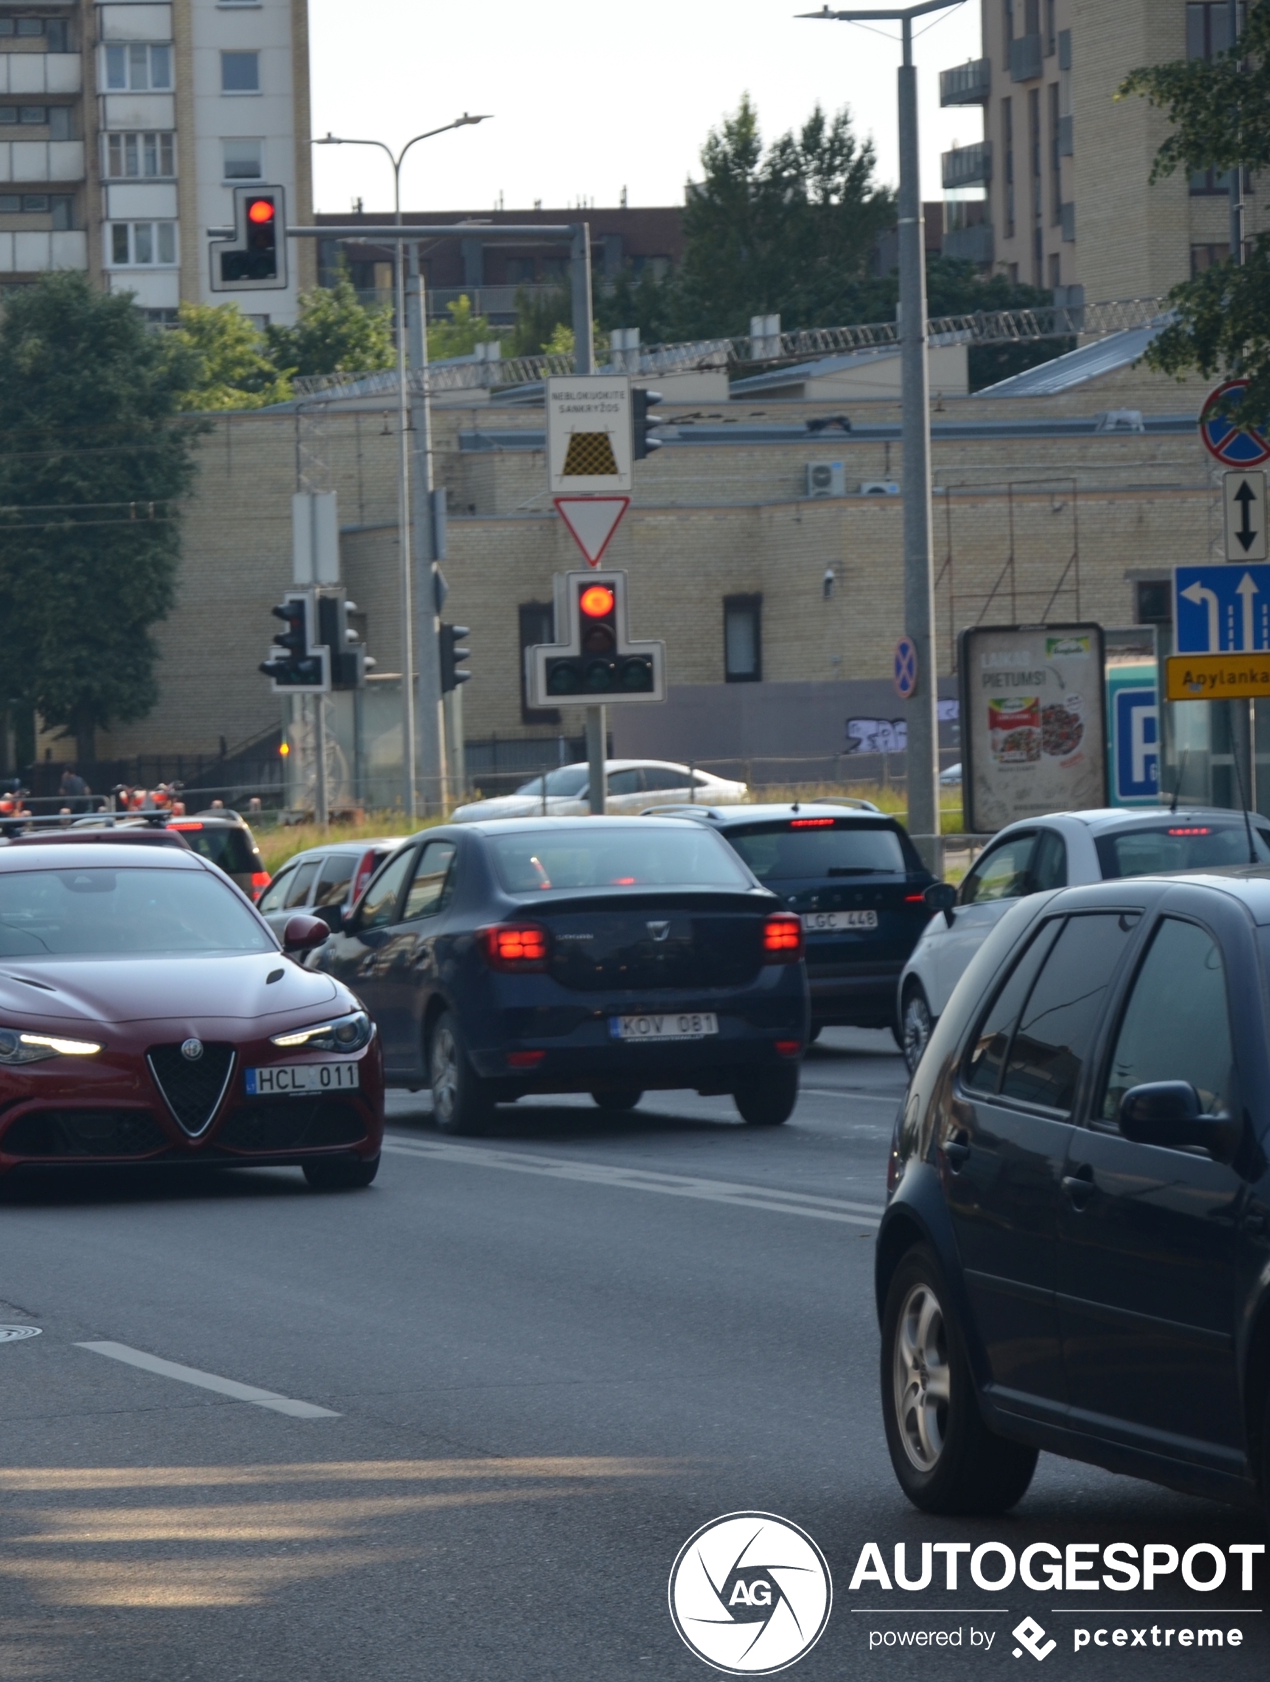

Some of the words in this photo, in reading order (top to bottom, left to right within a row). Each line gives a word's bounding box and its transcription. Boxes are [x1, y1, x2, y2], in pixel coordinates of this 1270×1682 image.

[552, 391, 625, 400] NEBLOKUOKITE
[559, 402, 620, 413] SANKRYŽOS
[805, 913, 837, 929] LGC
[847, 911, 876, 926] 448
[623, 1016, 664, 1035] KOV
[677, 1014, 714, 1032] 081
[259, 1068, 305, 1091] HCL
[320, 1065, 354, 1087] 011
